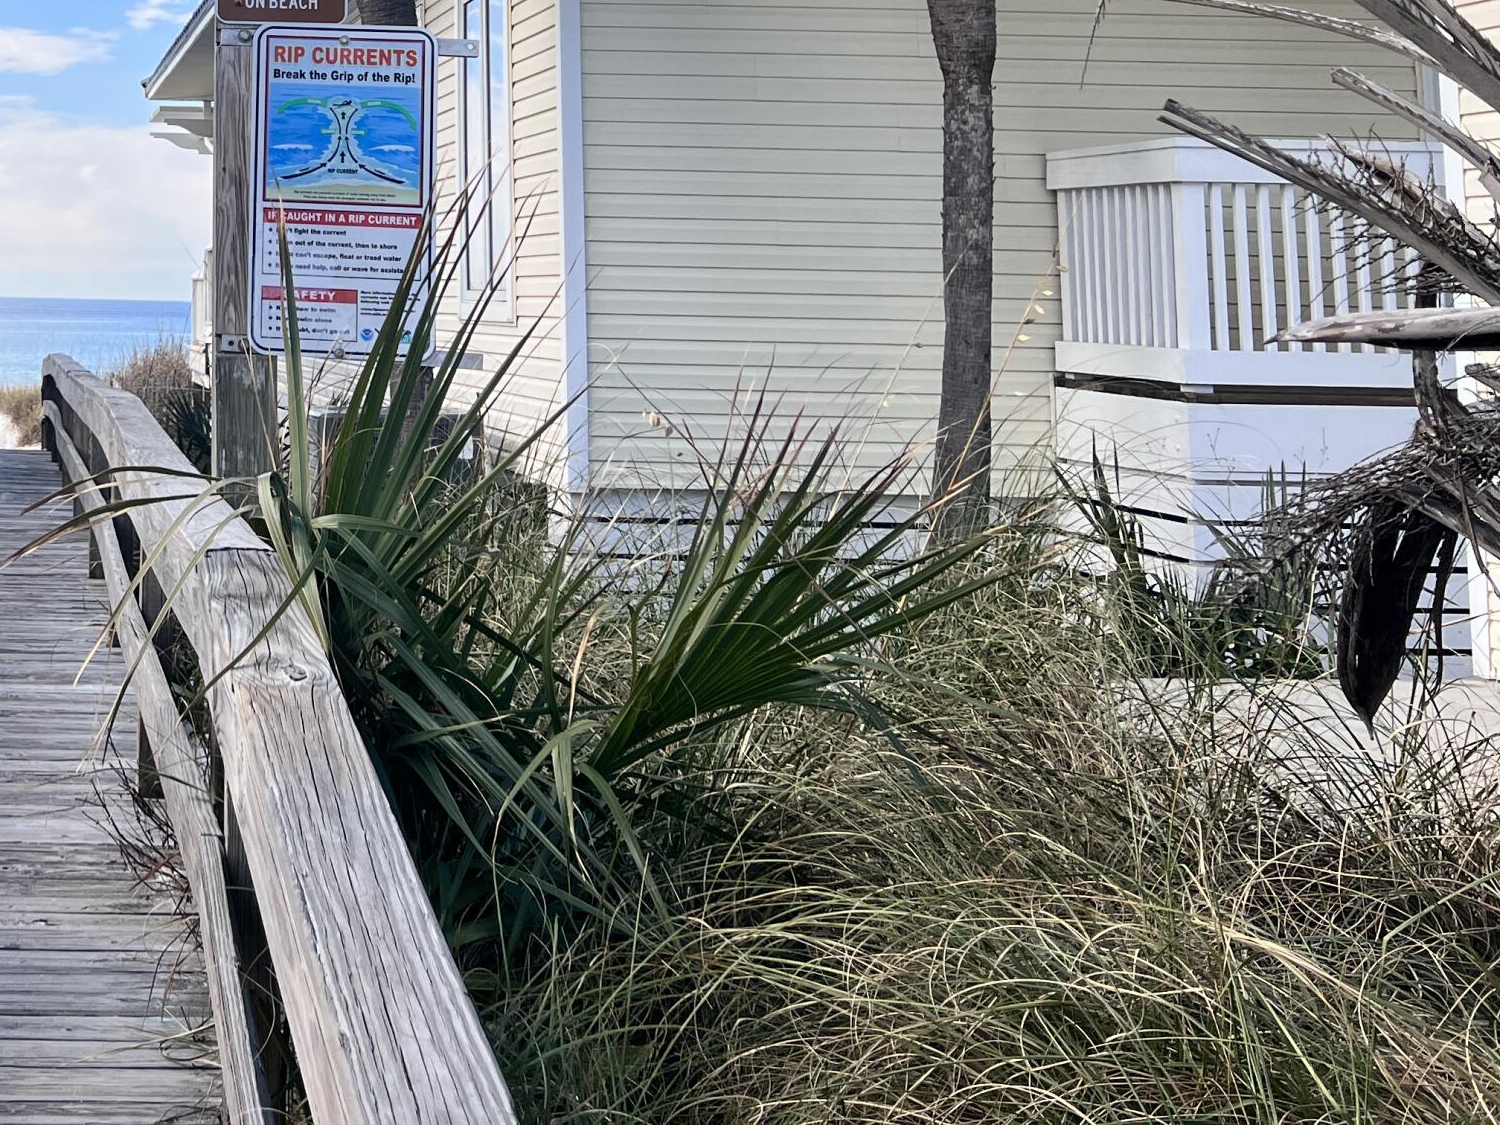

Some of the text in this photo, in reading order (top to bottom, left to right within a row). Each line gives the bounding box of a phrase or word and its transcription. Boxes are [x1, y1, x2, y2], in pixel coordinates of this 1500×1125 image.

[274, 45, 418, 67] RIP CURRENTS
[273, 68, 416, 85] Break the Grip of the Rip!
[283, 211, 322, 222] CAUGHT
[325, 212, 336, 222] IN
[338, 213, 346, 223] A
[348, 213, 365, 224] RIP
[368, 215, 417, 226] CURRENT
[294, 228, 309, 236] fight
